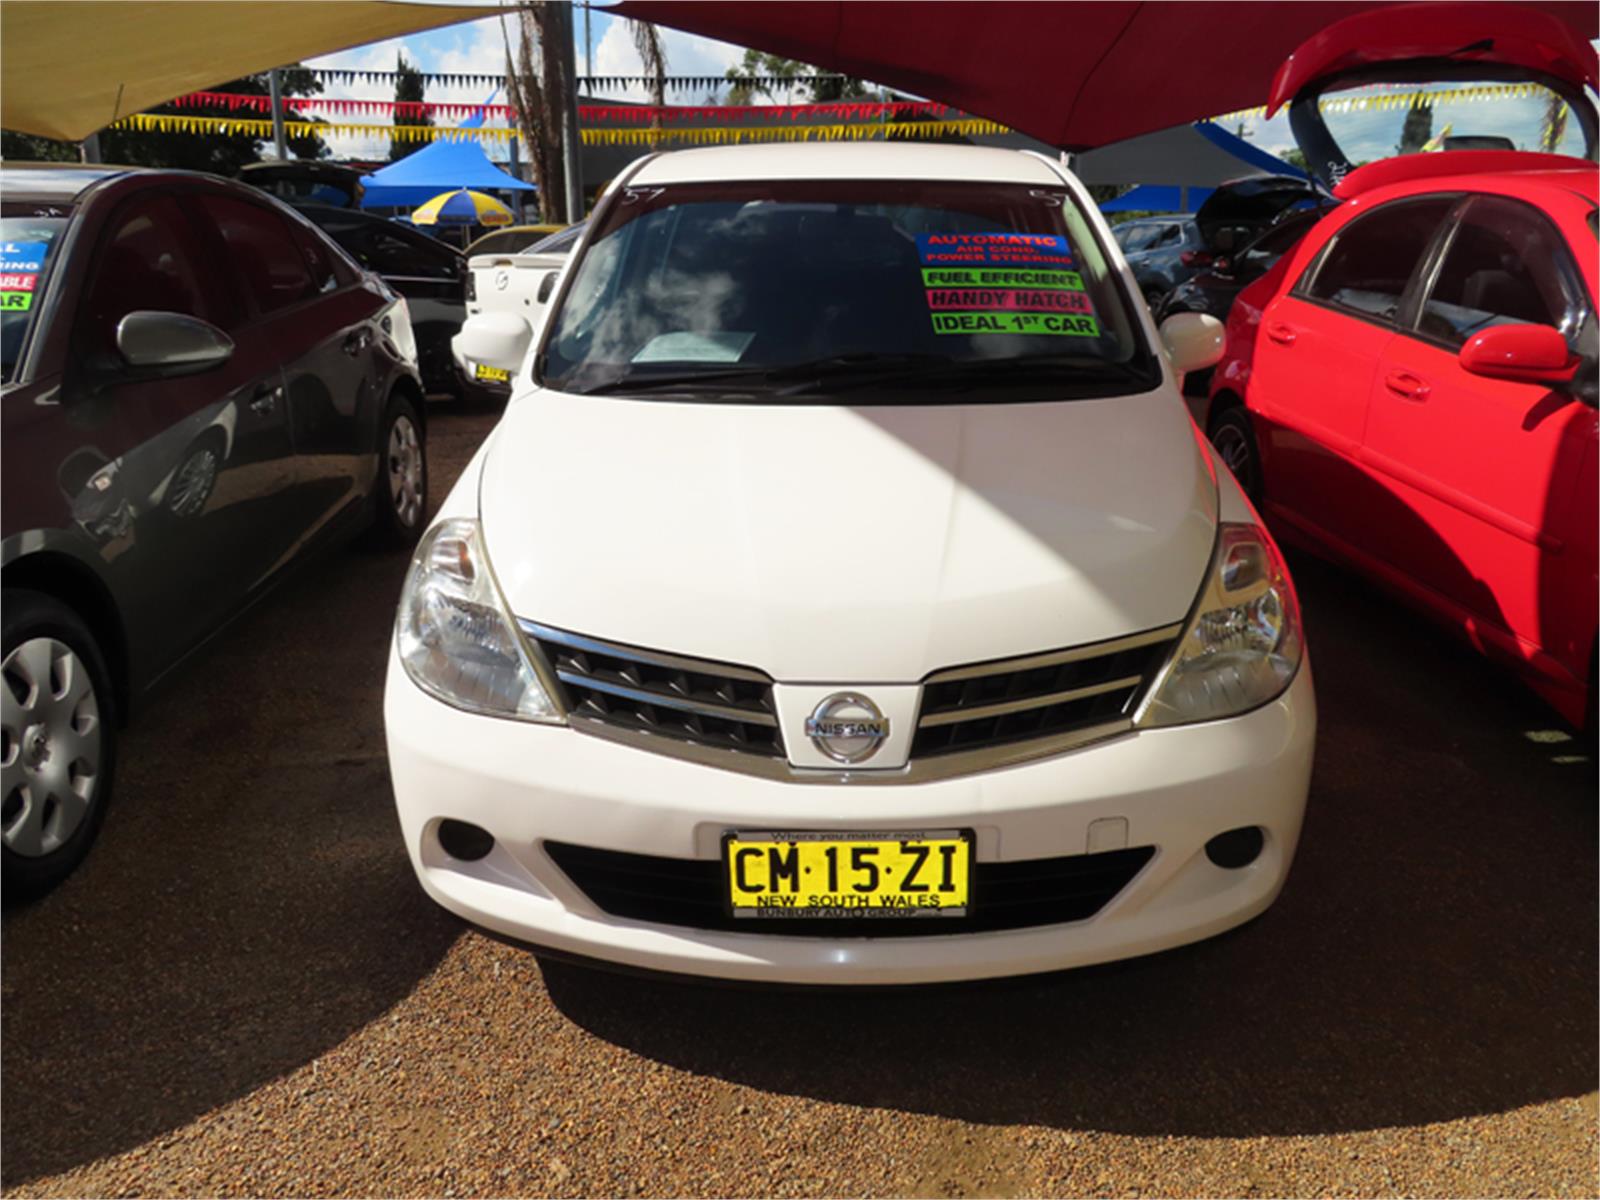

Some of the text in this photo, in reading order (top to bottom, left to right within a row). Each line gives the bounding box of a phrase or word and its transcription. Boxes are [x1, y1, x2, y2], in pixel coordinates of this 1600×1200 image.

[927, 234, 1057, 247] AUTOMATIC
[956, 245, 984, 253] AIR
[926, 253, 1073, 264] POWER STEERING
[927, 271, 1078, 287] FUEL EFFICIENT
[931, 291, 1086, 308] HANDY HATCH
[934, 315, 1094, 334] IDEAL 1ST CAR
[815, 722, 880, 735] NISSAN
[771, 831, 815, 841] Where
[819, 833, 844, 841] you
[847, 832, 889, 841] matter
[757, 895, 941, 907] NEW SOUTH WALES
[757, 907, 820, 917] BUNBURY
[823, 907, 864, 918] AUTO
[867, 907, 916, 917] GROUP
